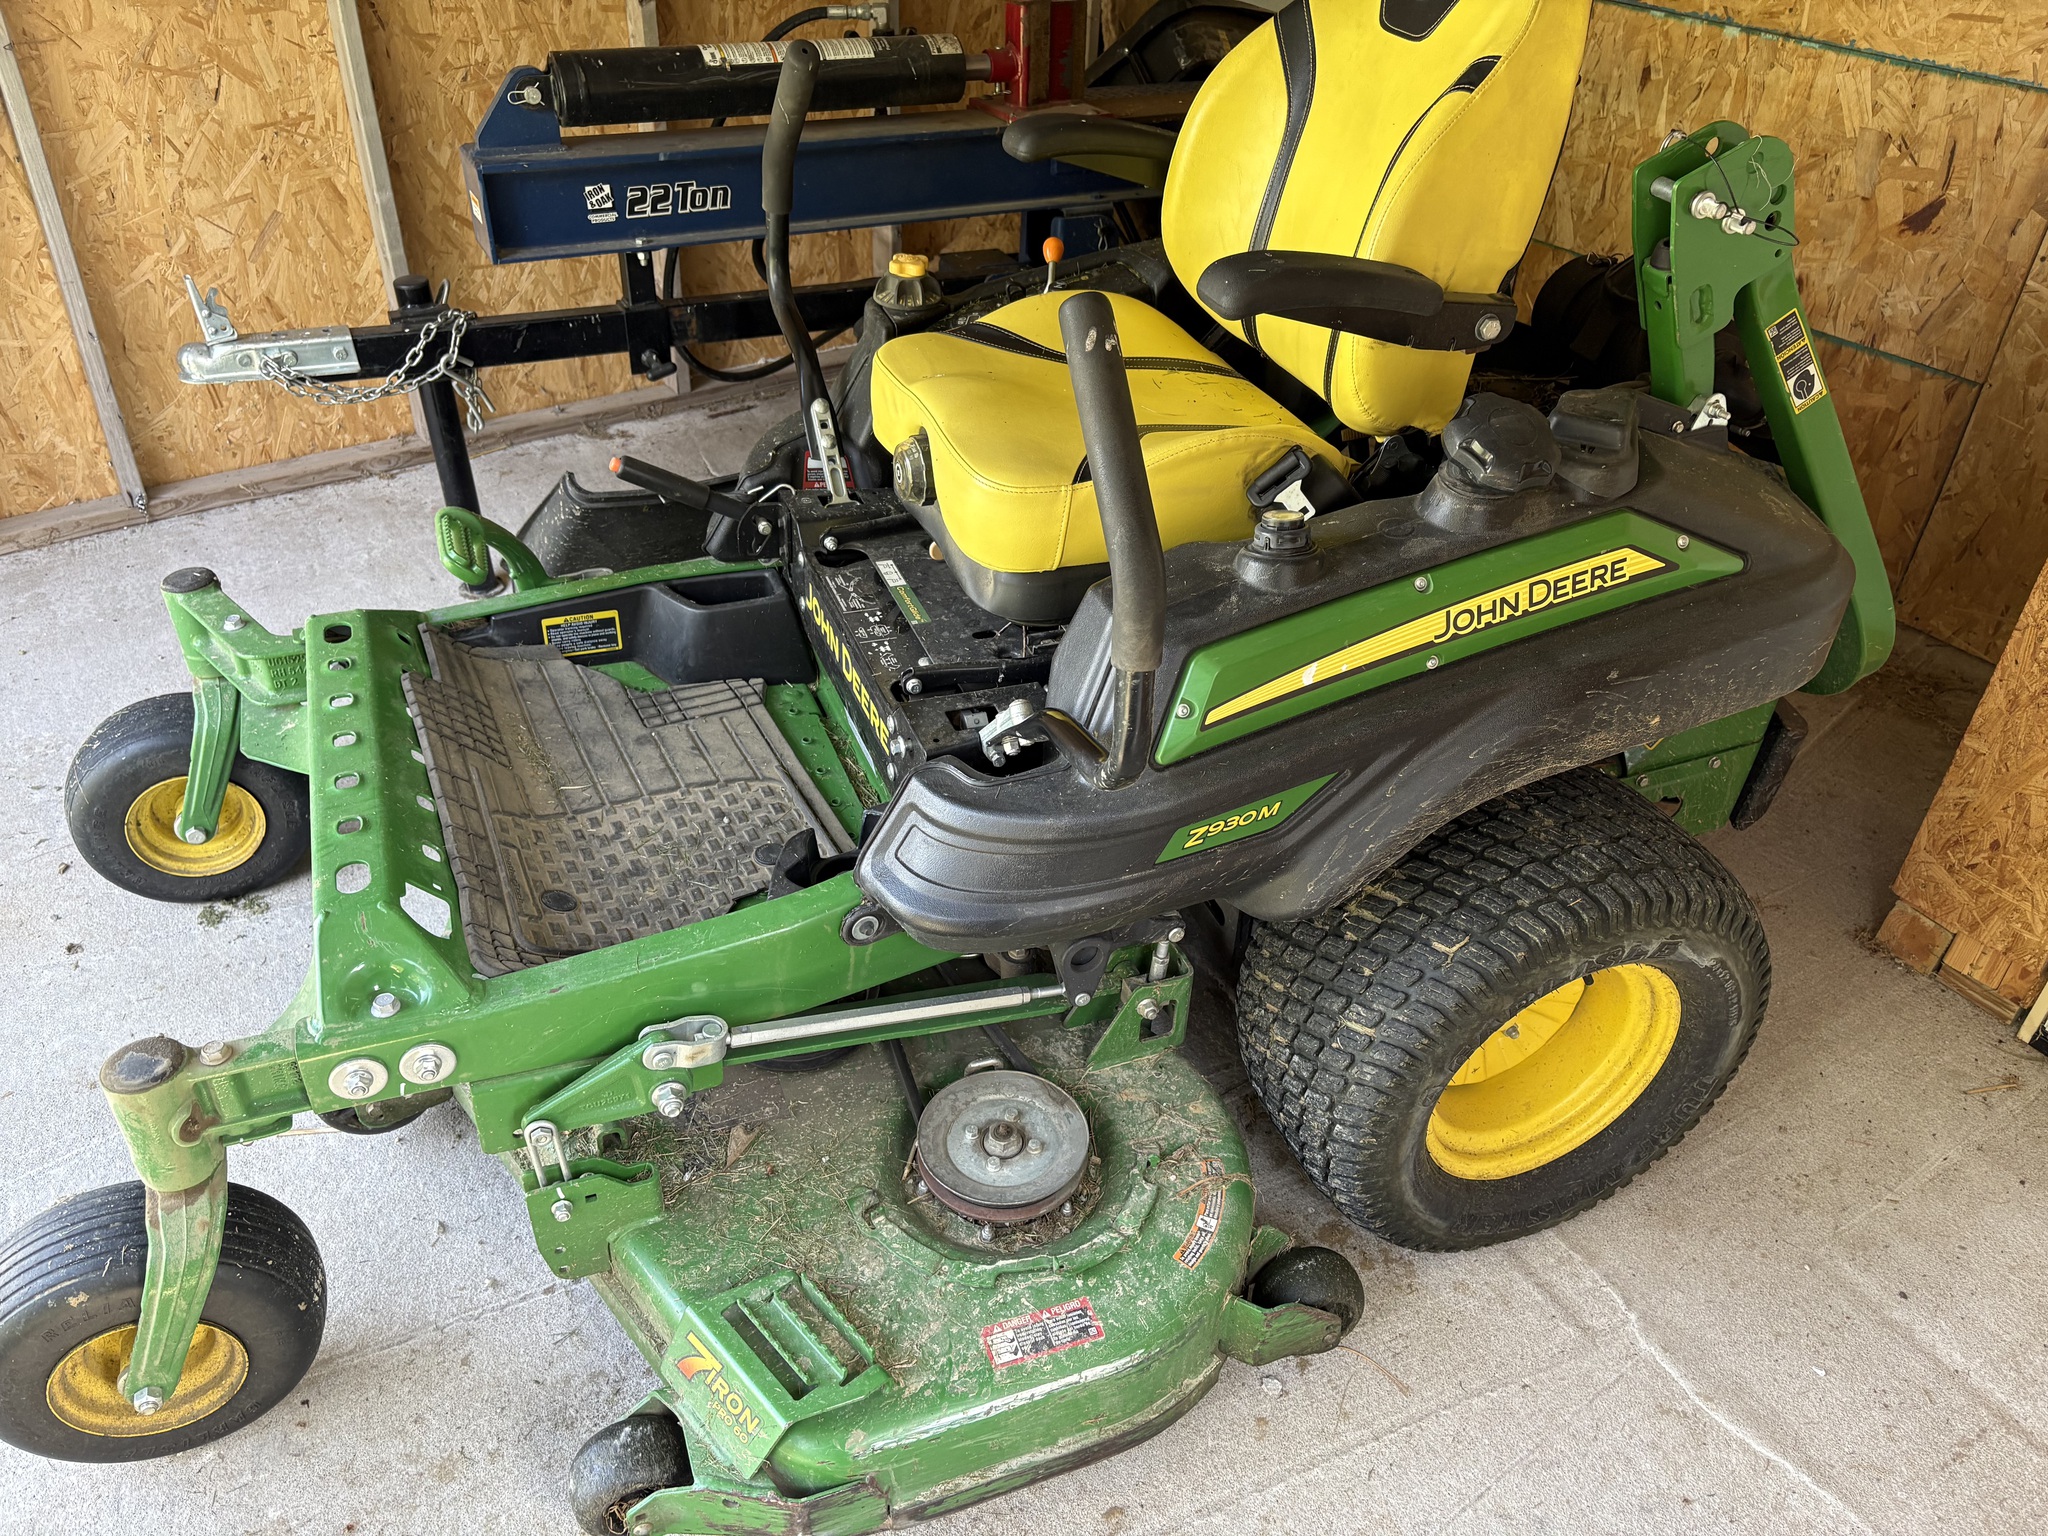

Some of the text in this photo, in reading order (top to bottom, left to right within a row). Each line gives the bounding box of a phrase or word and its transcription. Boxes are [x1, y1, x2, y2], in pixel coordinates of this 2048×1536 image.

[584, 183, 605, 201] IRON
[626, 180, 731, 219] 22 Ton
[569, 614, 594, 622] CAUTION
[1434, 557, 1628, 642] JOHN DEERE
[806, 583, 840, 662] JOHN
[841, 642, 891, 757] DEERE
[1182, 800, 1284, 850] Z930M
[40, 1296, 138, 1343] RELIA
[1001, 1314, 1032, 1330] DANGER
[1050, 1299, 1081, 1316] PELIGRO
[711, 1400, 749, 1445] PRO 60
